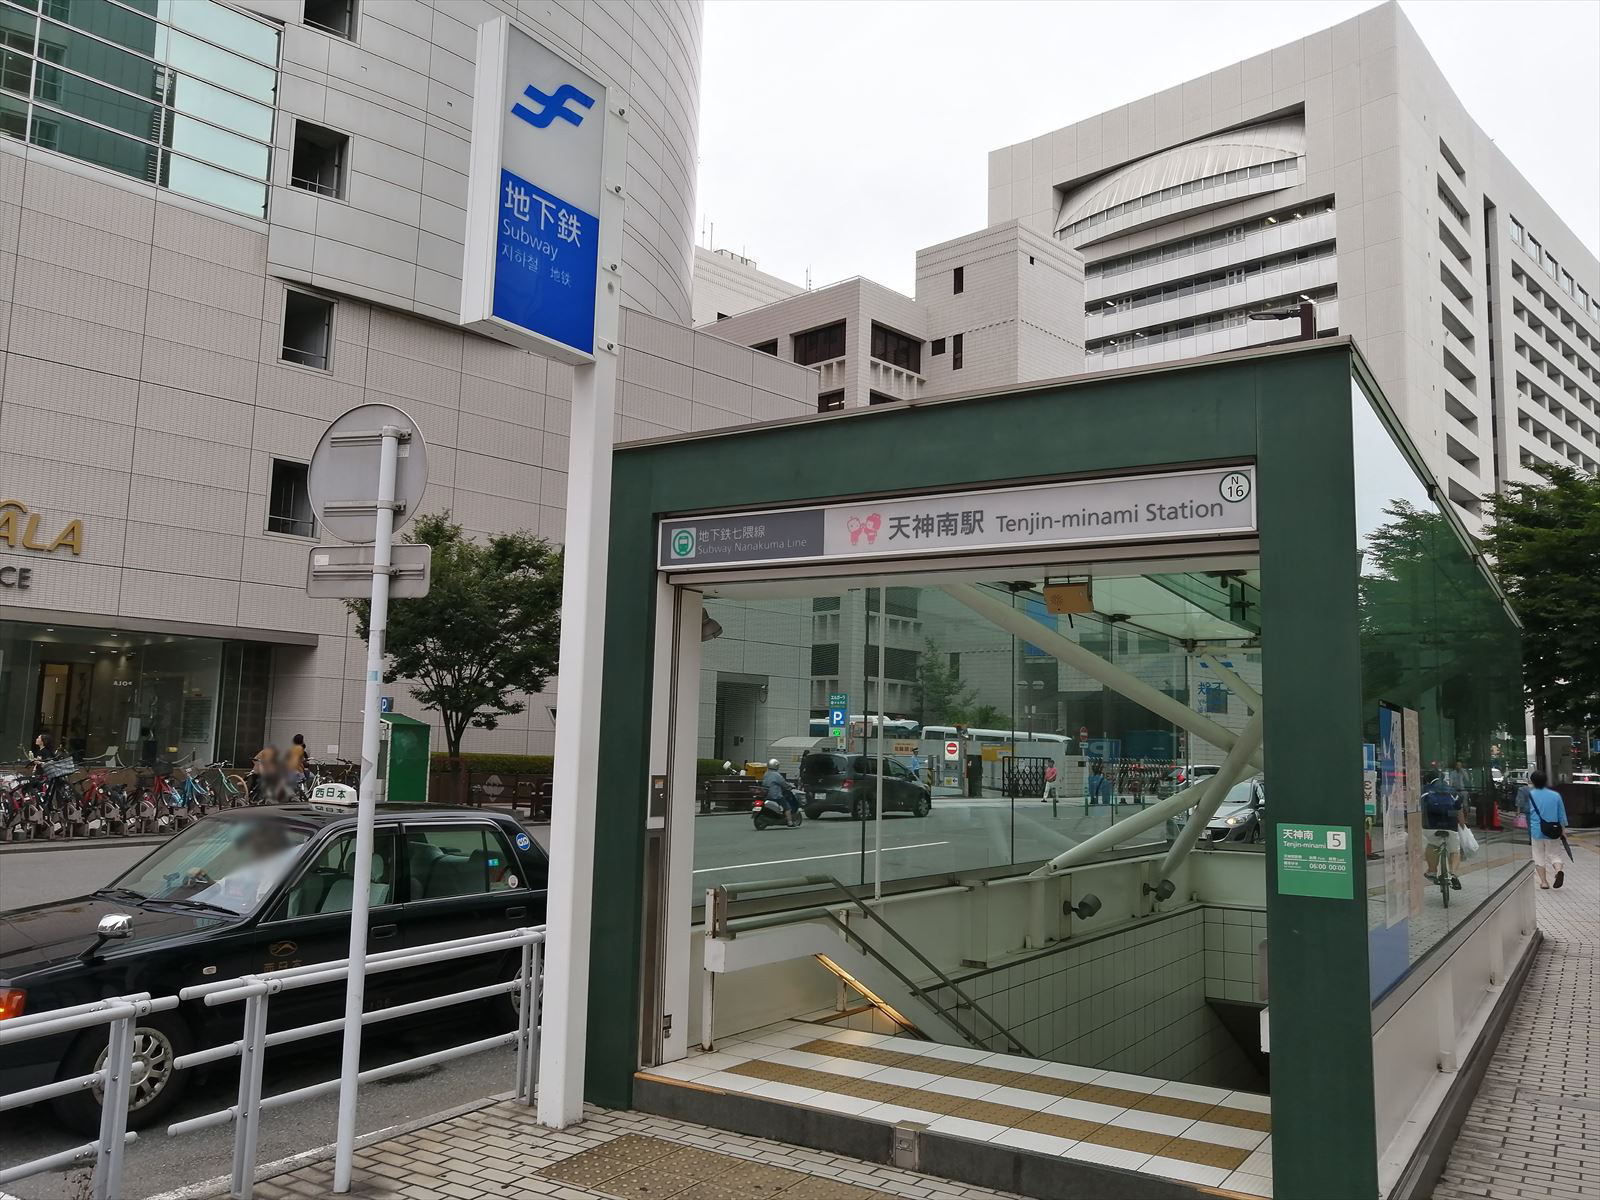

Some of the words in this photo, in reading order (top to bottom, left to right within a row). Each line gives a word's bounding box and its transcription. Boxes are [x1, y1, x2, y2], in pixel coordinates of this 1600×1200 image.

[504, 180, 581, 248] 地下鉄
[503, 218, 559, 261] Subway
[1231, 475, 1239, 485] N
[1227, 485, 1244, 498] 16
[996, 503, 1140, 534] Tenjin-minami
[1145, 497, 1224, 521] Station
[888, 509, 985, 541] 天神南駅
[698, 525, 766, 543] 地下鉄七隈線
[697, 544, 732, 555] Subway
[734, 539, 785, 552] Nanakuma
[787, 537, 807, 548] Line
[833, 711, 843, 725] P
[315, 787, 346, 799] 西日本
[1282, 829, 1314, 841] 天神南
[1332, 834, 1341, 847] 5
